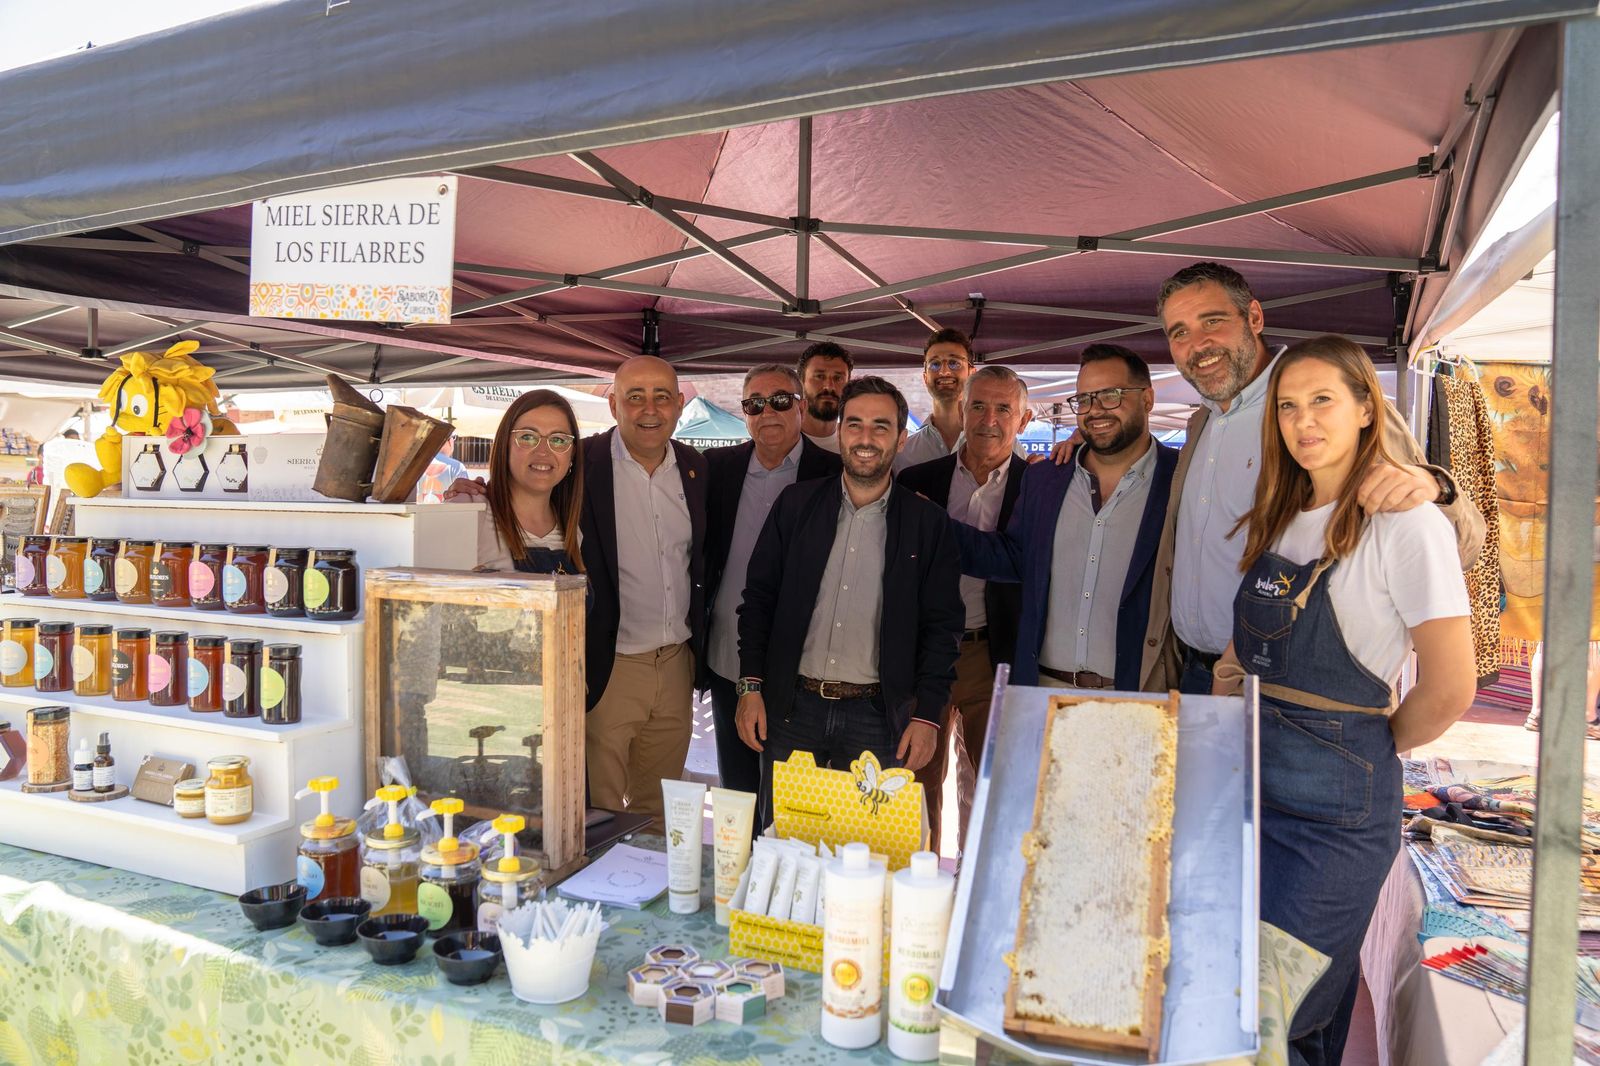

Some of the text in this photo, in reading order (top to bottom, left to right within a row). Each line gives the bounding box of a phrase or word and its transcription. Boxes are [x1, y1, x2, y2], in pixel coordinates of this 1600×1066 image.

[265, 202, 441, 227] MIEL SIERRA DE
[275, 241, 425, 264] LOS FILABRES
[693, 439, 738, 447] ZURGENA
[1031, 443, 1045, 452] DE
